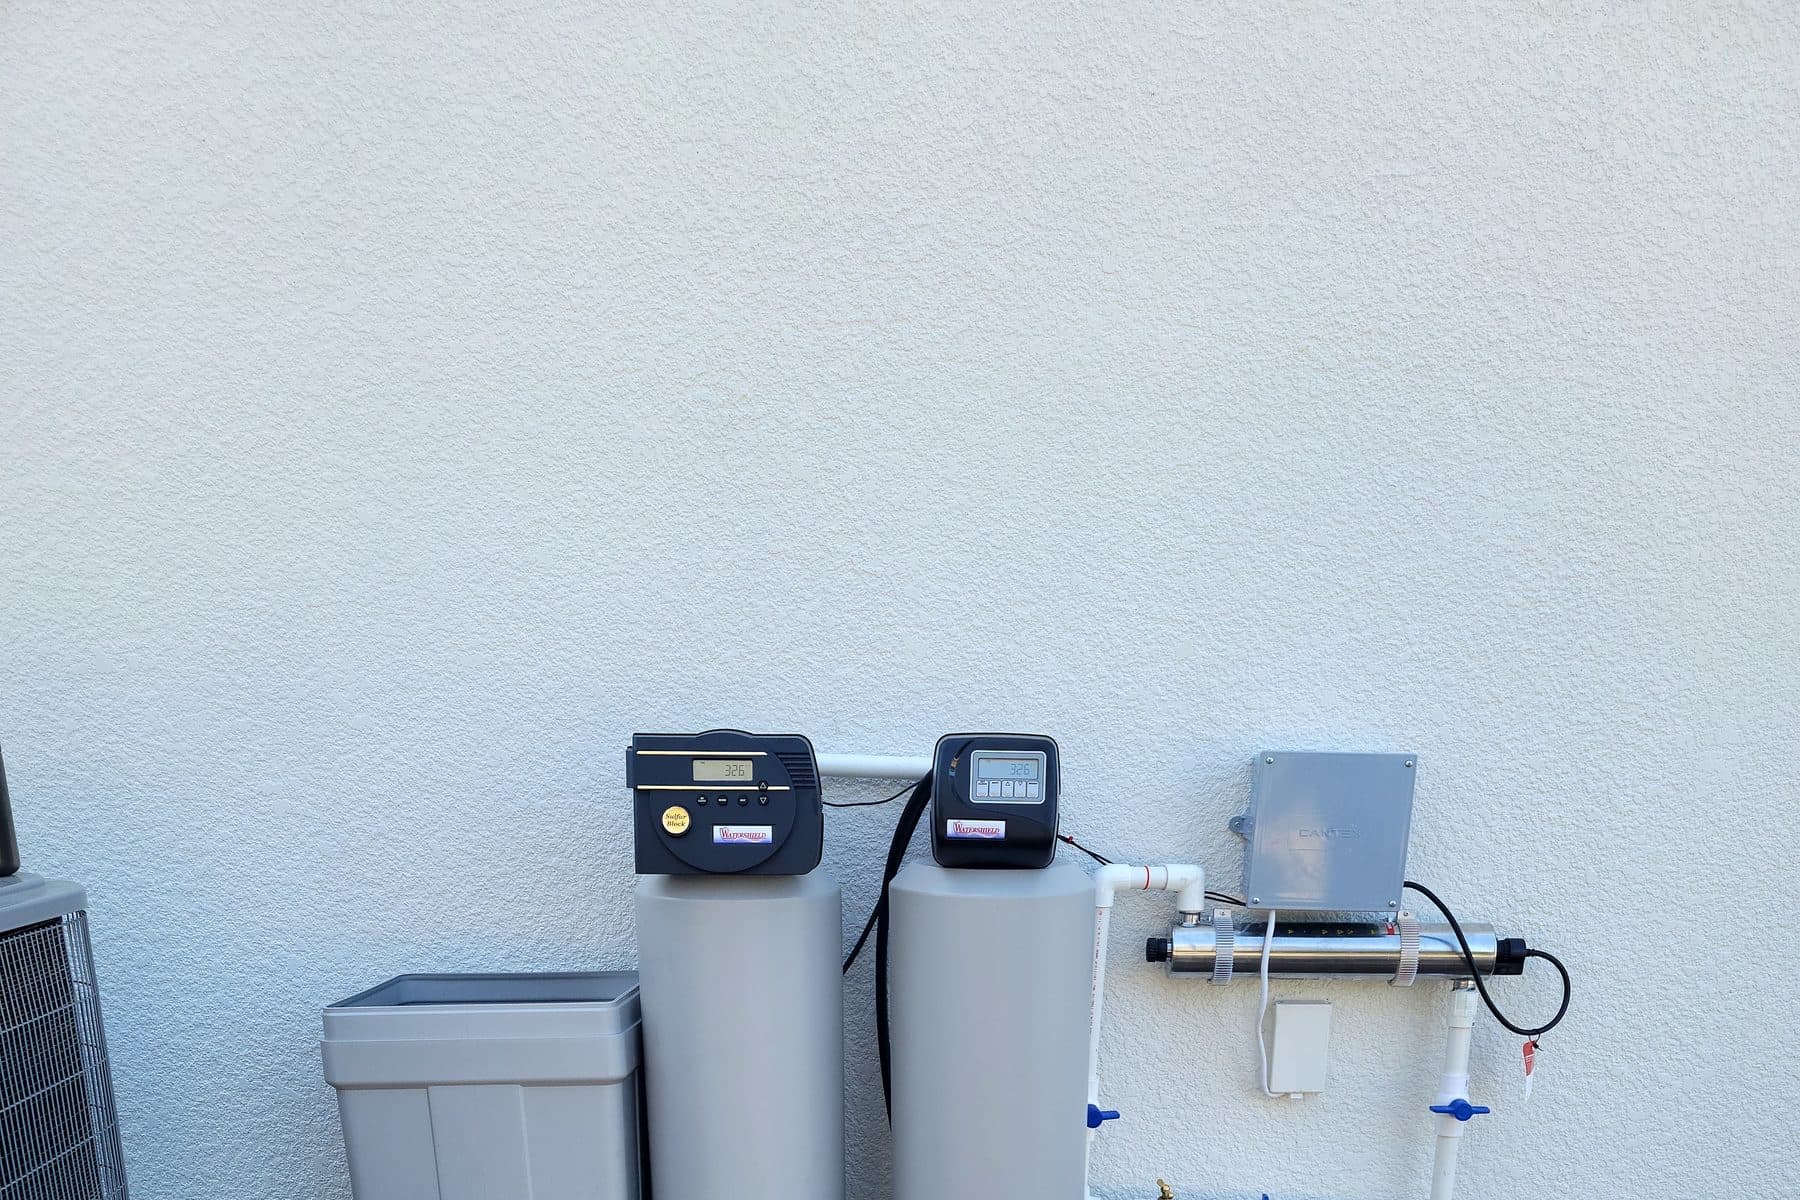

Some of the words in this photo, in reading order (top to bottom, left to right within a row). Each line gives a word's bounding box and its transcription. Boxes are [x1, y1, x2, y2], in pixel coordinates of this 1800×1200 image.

[724, 764, 745, 777] 326
[1010, 763, 1030, 776] 326
[665, 813, 687, 821] Sulfur
